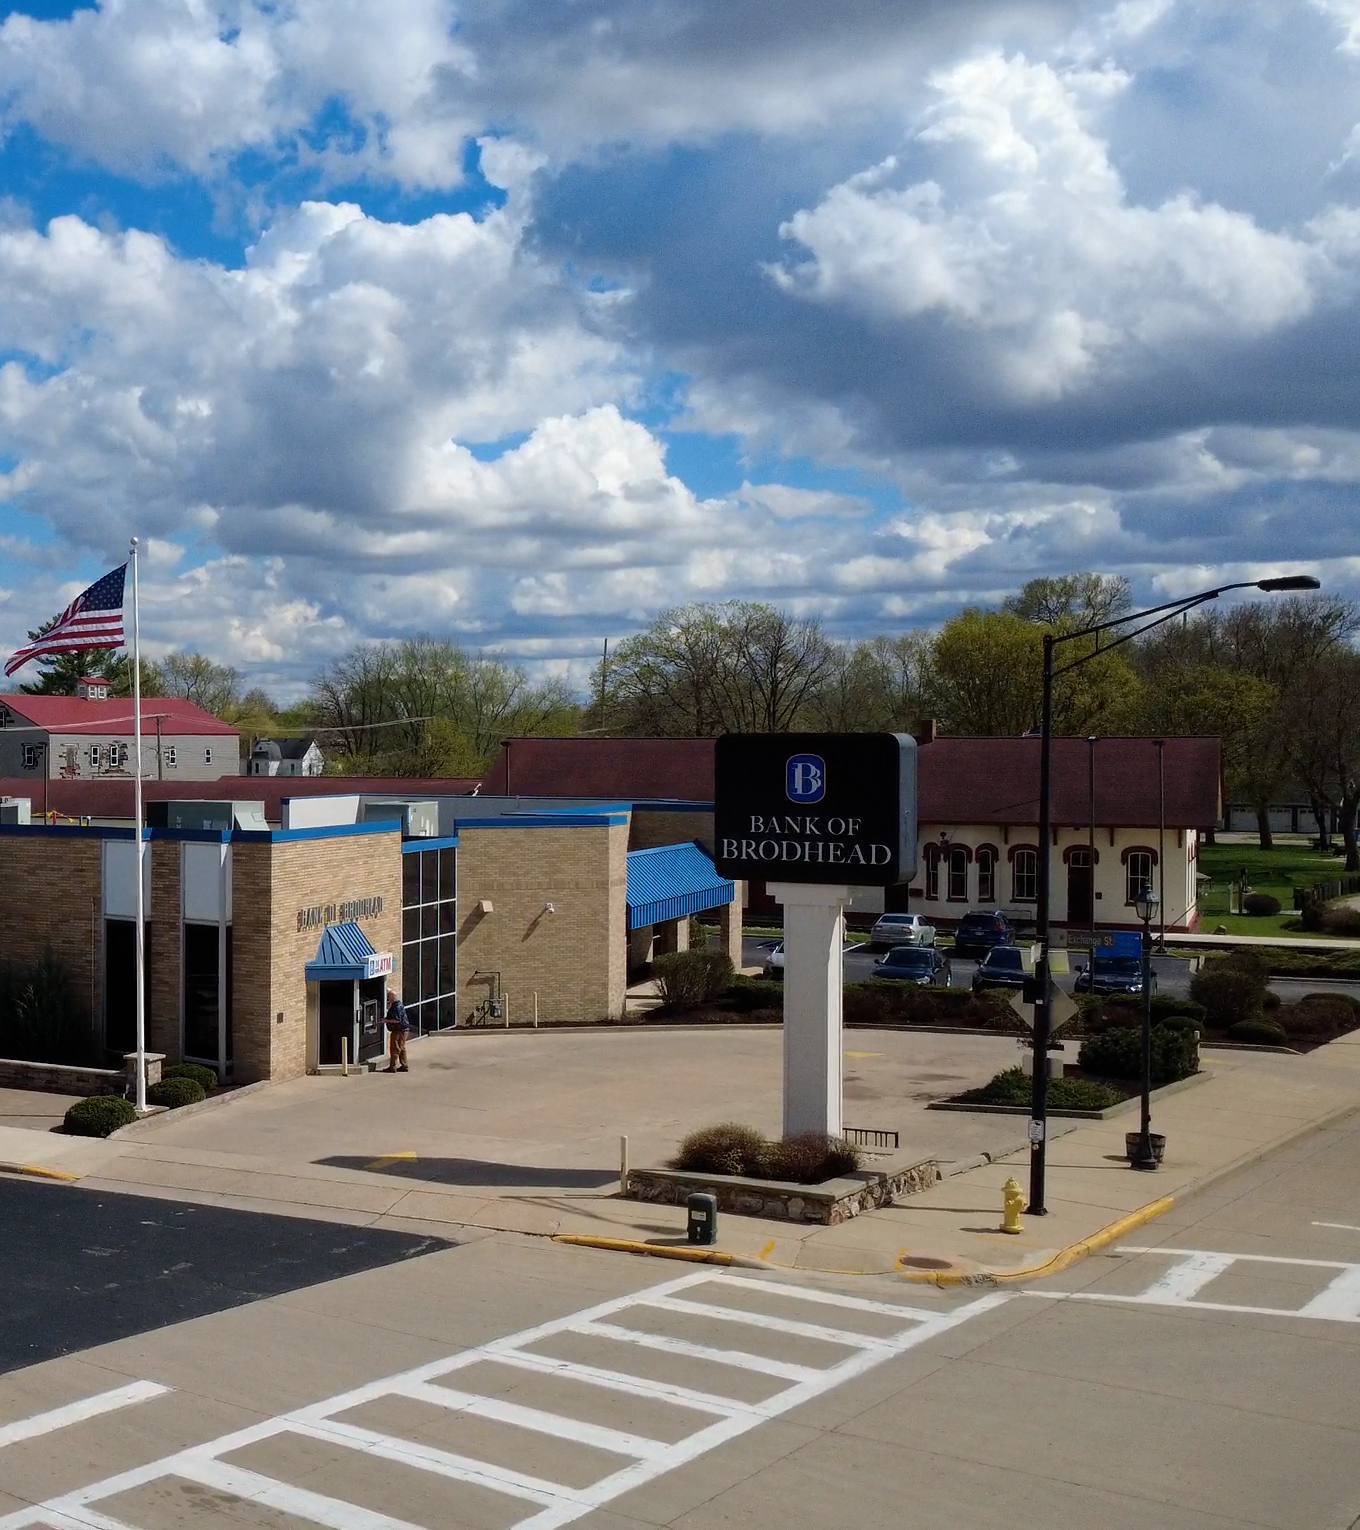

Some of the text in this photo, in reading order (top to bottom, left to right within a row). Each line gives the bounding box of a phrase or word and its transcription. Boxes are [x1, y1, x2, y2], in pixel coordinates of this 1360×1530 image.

[750, 815, 862, 836] BANK OF
[721, 838, 892, 866] BRODHEAD
[1068, 934, 1101, 947] Exchange
[380, 957, 391, 973] ATM
